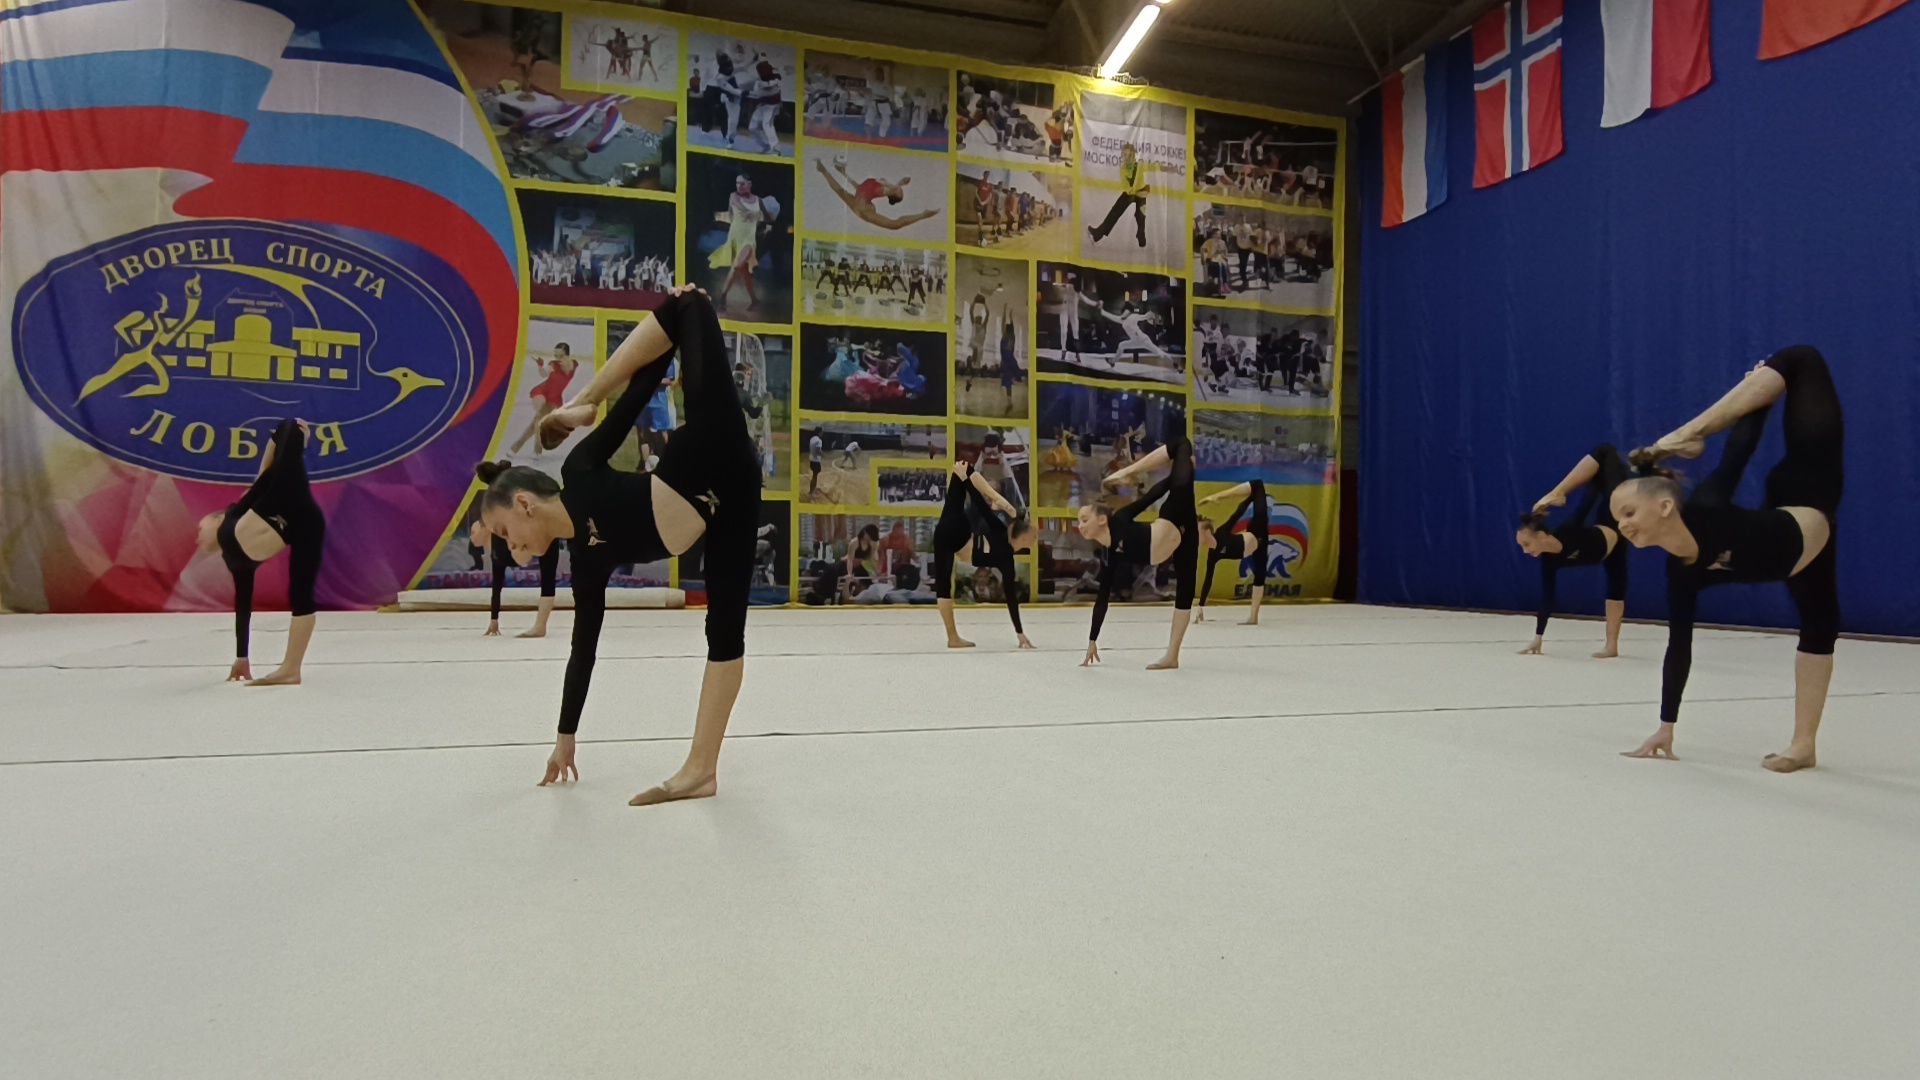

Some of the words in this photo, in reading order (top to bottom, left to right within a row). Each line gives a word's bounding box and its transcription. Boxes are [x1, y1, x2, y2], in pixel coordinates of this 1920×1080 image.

[1091, 136, 1151, 154] ФЕДЕРЦИЯ
[100, 237, 235, 294] ДВОРЕЦ
[266, 241, 386, 300] СПОРТА
[129, 408, 349, 460] ЛОБЯ
[1234, 583, 1302, 599] ЕДНАЯ
